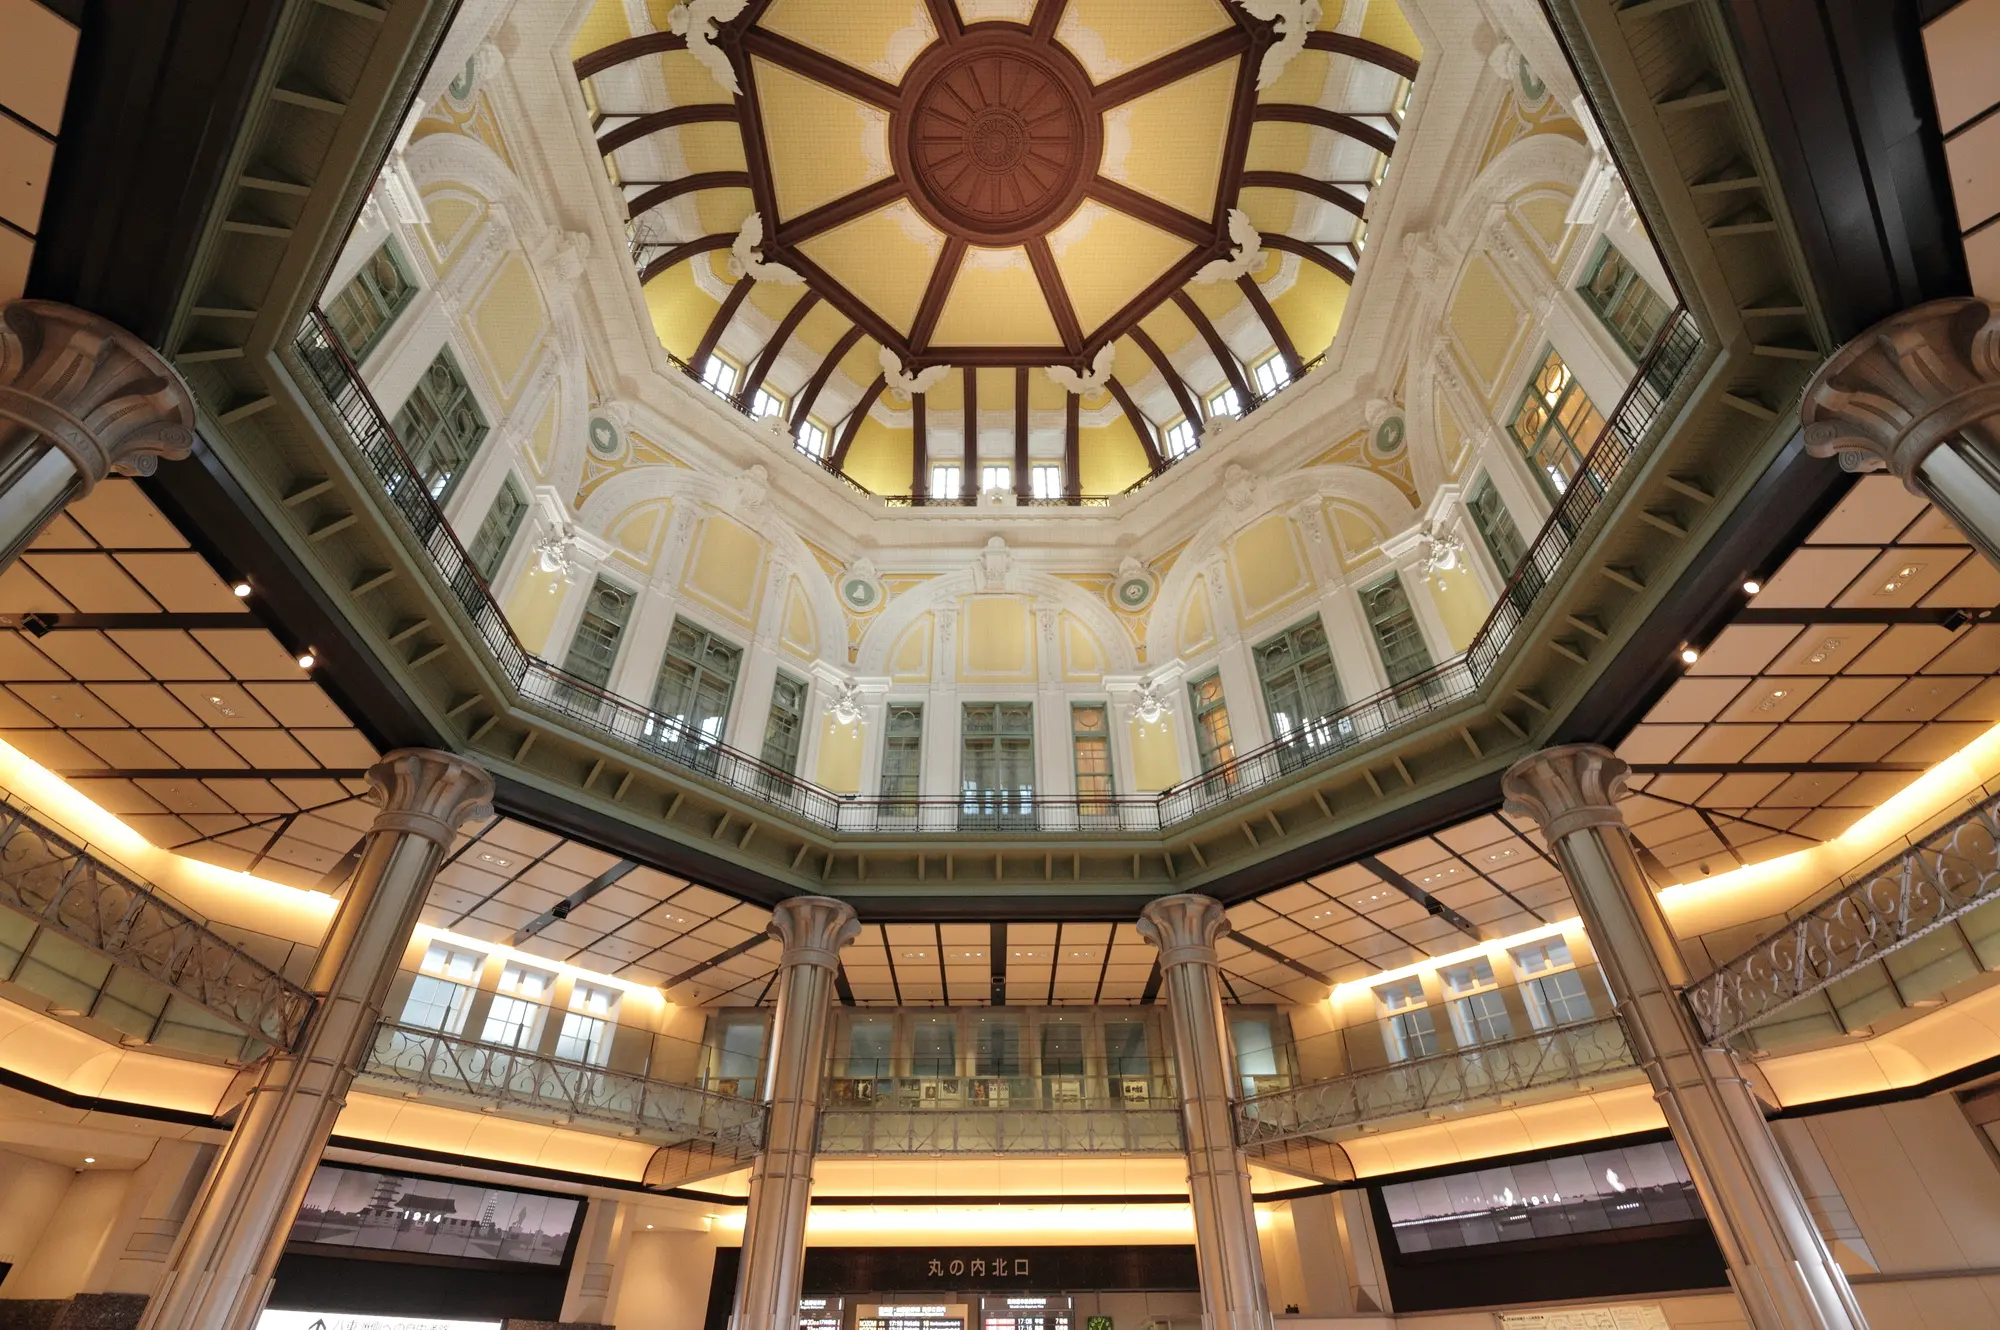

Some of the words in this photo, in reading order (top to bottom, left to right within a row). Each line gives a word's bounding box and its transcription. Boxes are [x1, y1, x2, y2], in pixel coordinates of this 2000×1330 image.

[1522, 1192, 1561, 1207] 1914
[404, 1210, 442, 1224] 1914
[928, 1258, 1029, 1277] 丸の内北口
